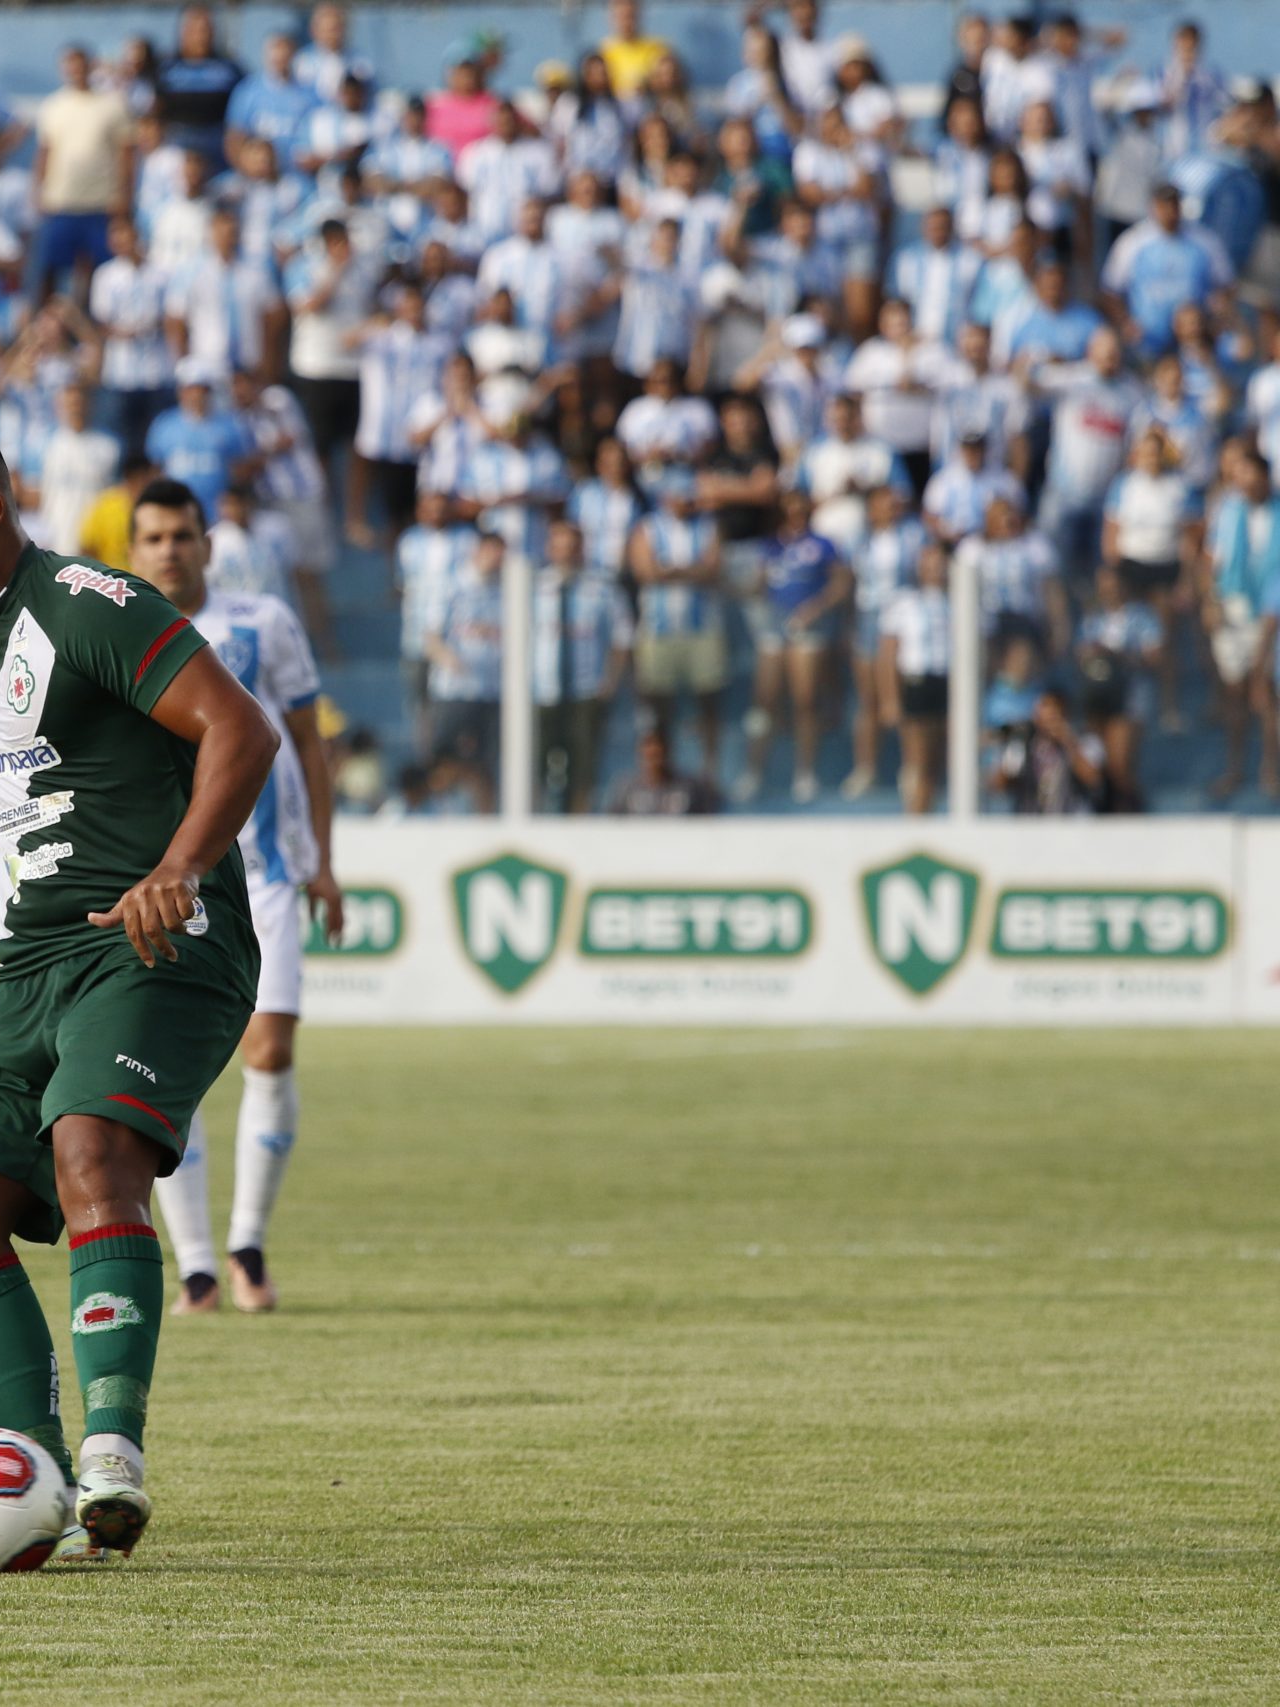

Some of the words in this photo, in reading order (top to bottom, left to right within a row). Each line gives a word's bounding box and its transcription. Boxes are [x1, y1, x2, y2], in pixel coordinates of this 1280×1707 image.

[56, 565, 135, 606] URBIX
[26, 844, 72, 865] Oncológica
[467, 870, 553, 963] N
[588, 895, 802, 952] BET91
[876, 870, 964, 963] N
[1001, 895, 1217, 952] BET91
